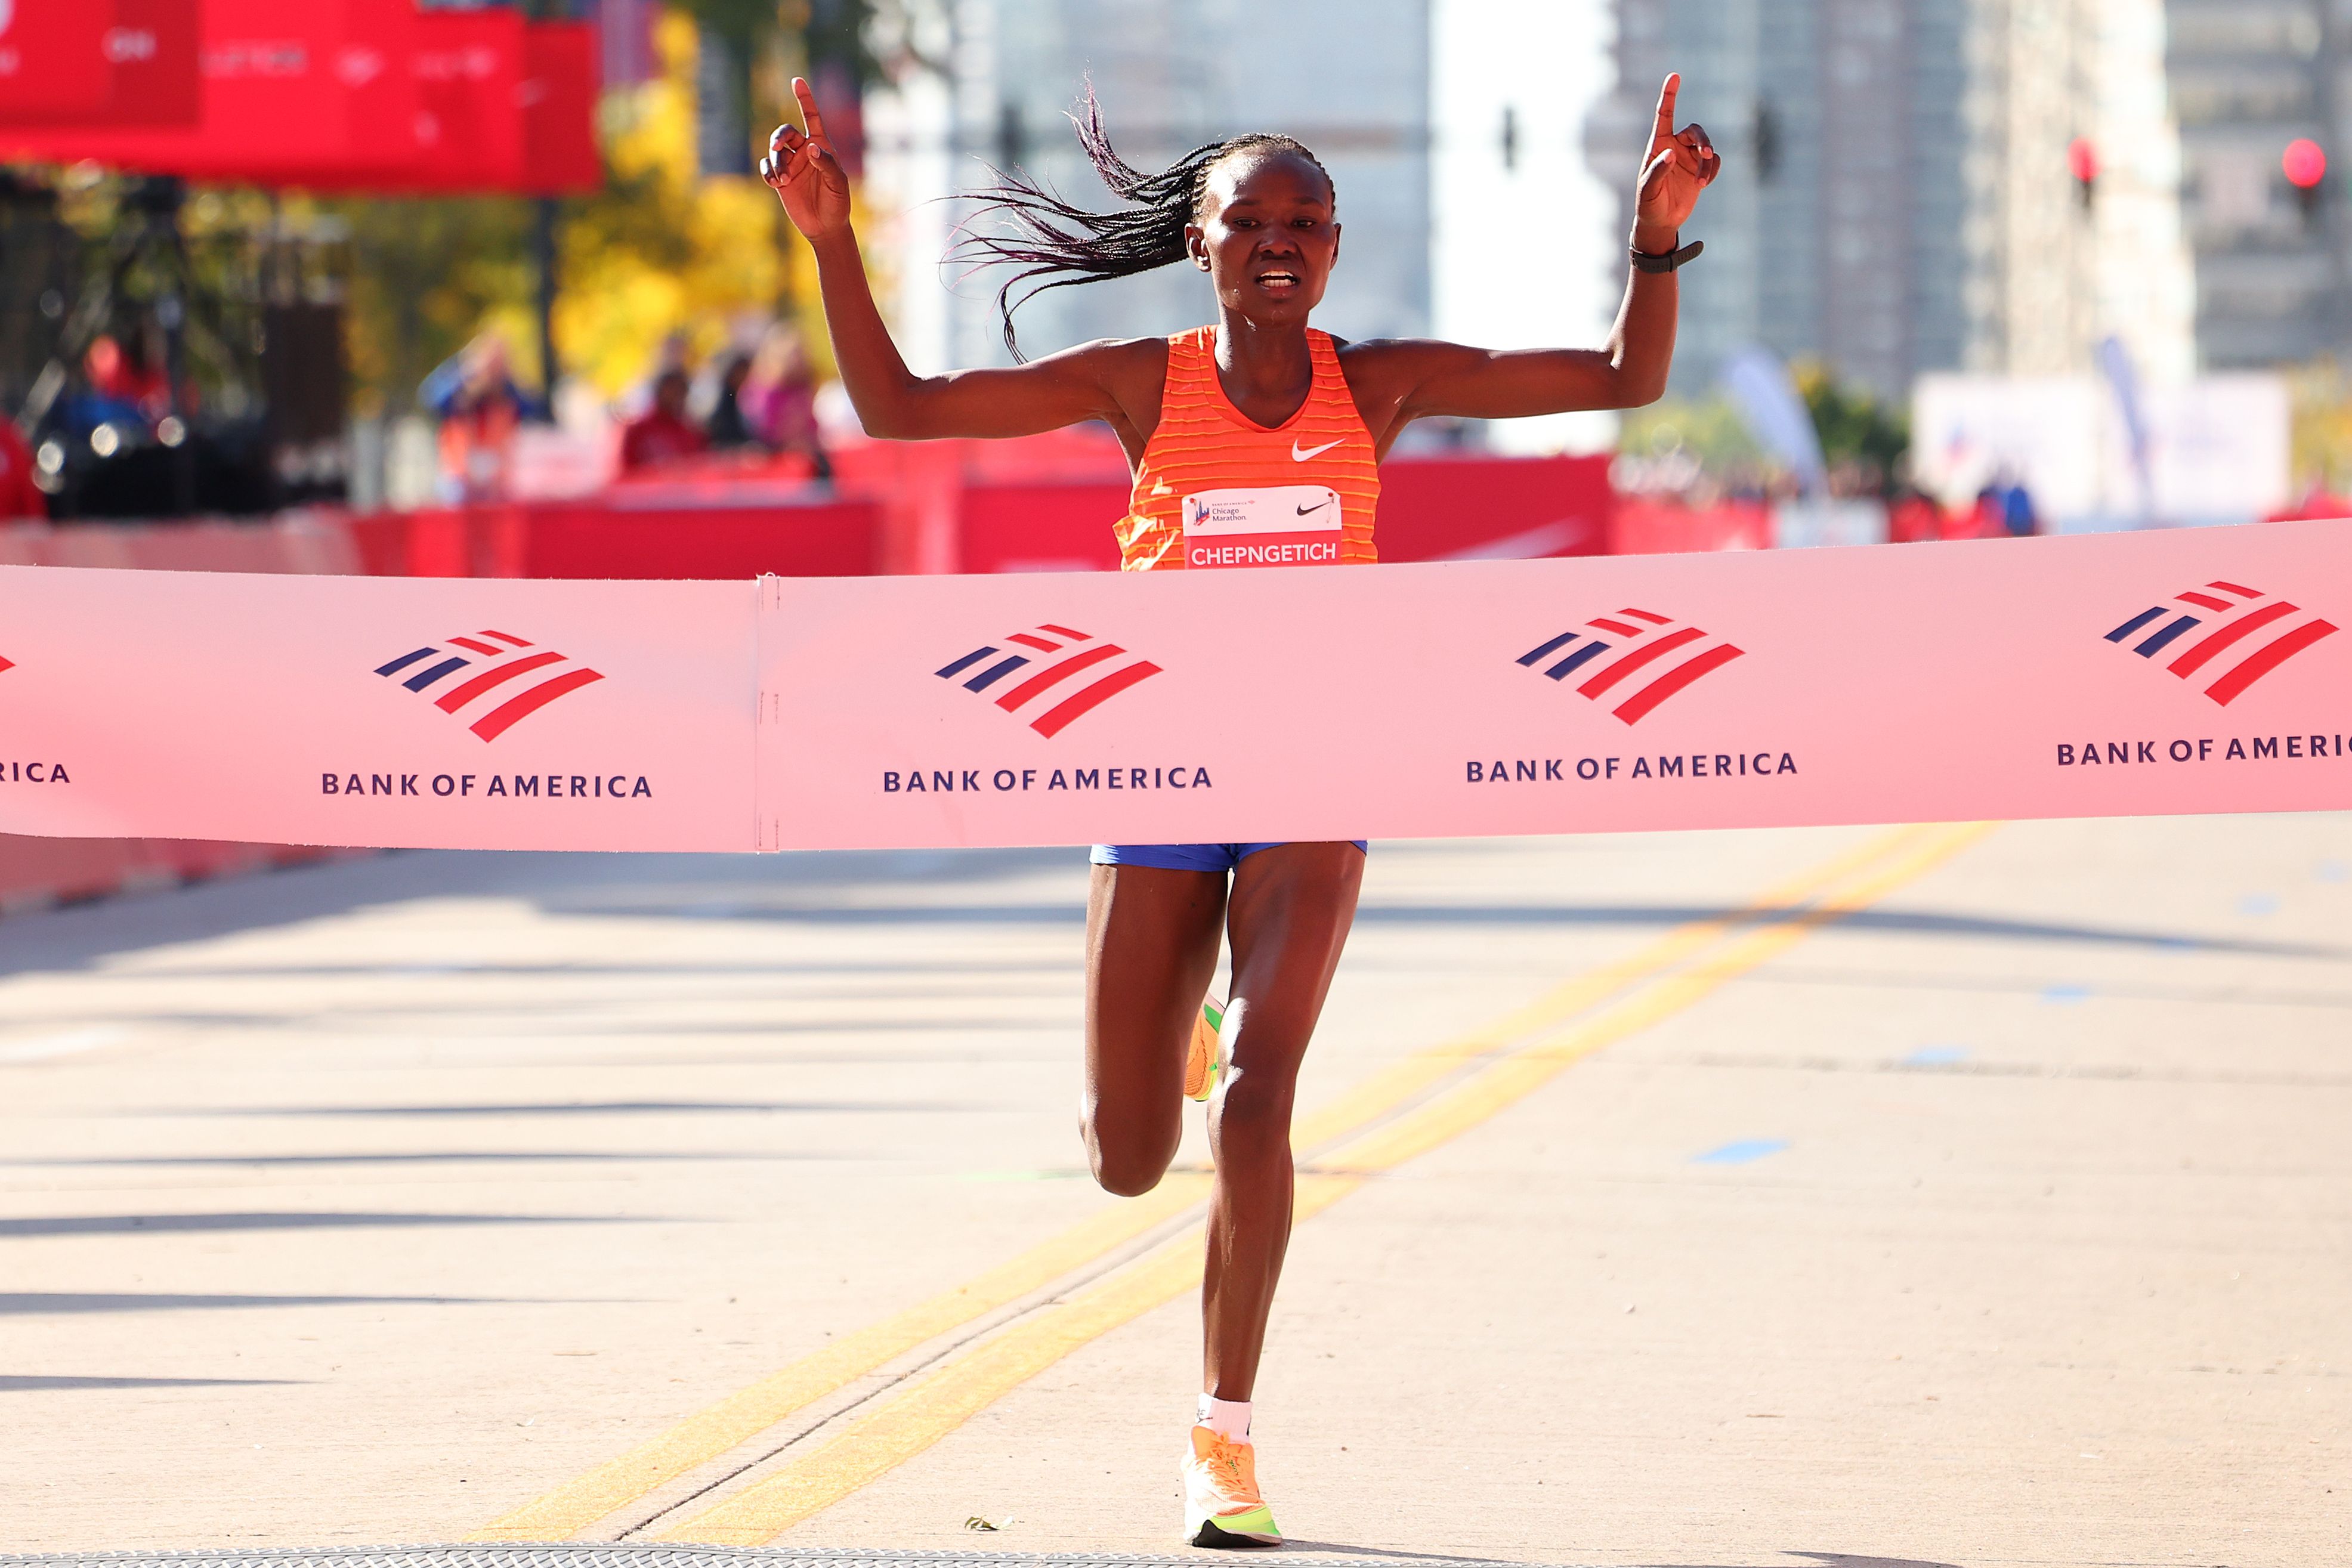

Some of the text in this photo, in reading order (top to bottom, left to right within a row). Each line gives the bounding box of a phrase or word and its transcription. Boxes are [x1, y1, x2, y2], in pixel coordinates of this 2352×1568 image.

[1191, 543, 1336, 565] CHEPNGETICH
[2057, 734, 2352, 766] BANK OF AMERI
[884, 767, 1212, 793] BANK OF AMERICA
[1467, 753, 1797, 783] BANK OF AMERICA
[322, 773, 652, 798] BANK OF AMERICA
